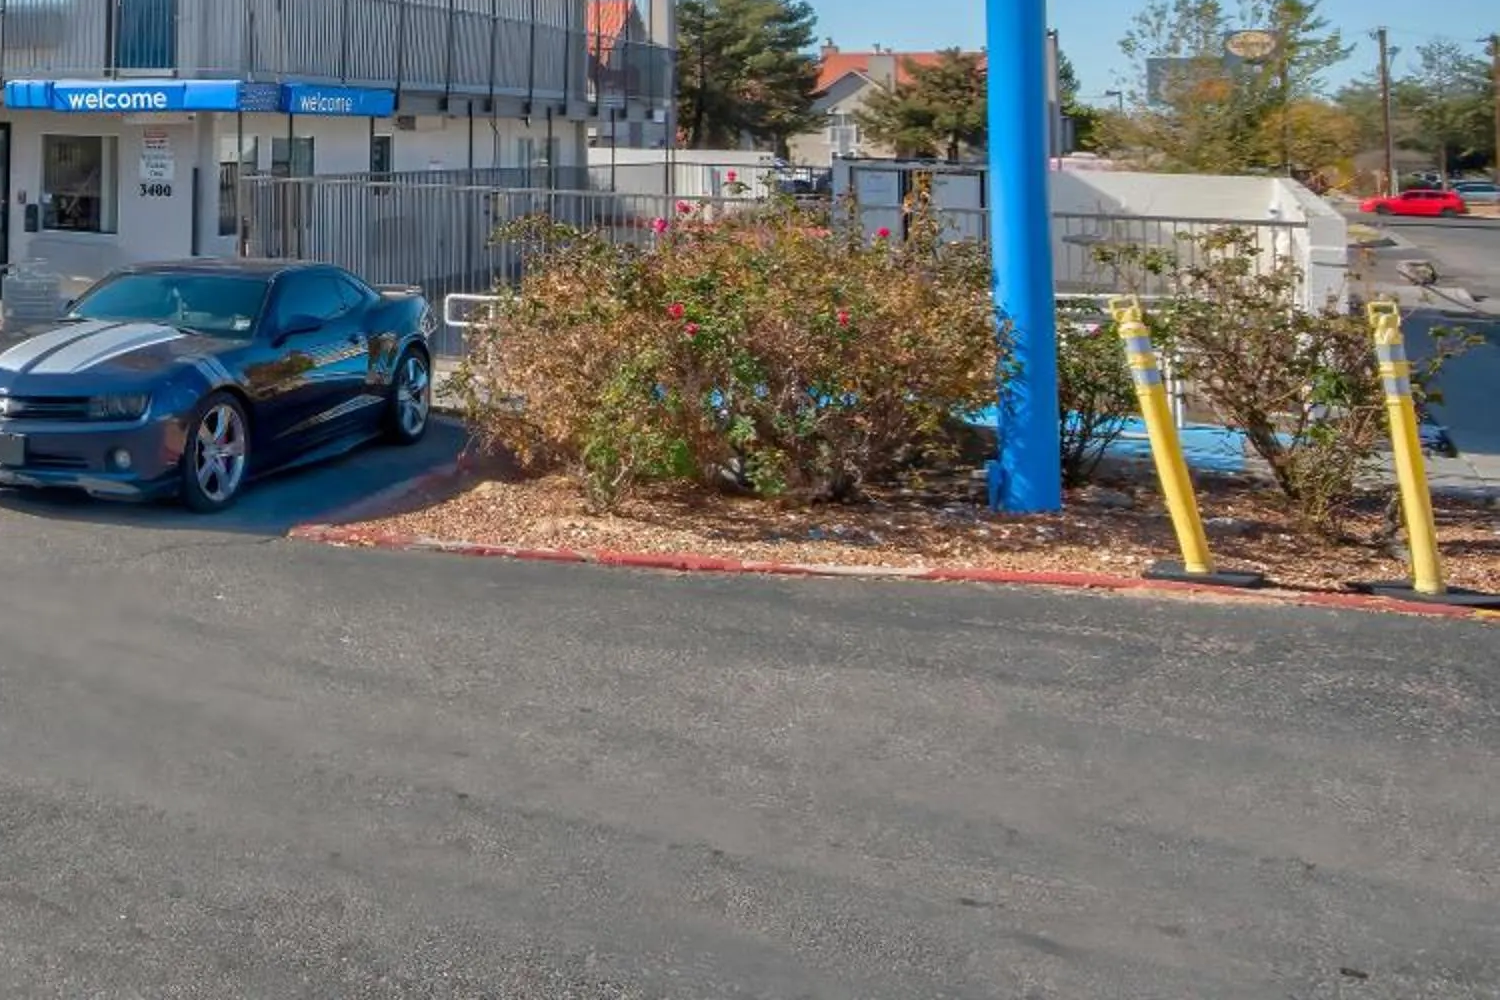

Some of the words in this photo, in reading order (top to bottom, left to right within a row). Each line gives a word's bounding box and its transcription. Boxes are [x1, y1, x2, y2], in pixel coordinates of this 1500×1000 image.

[68, 88, 167, 109] welcome
[301, 92, 353, 112] welcome
[139, 183, 173, 198] 3400
